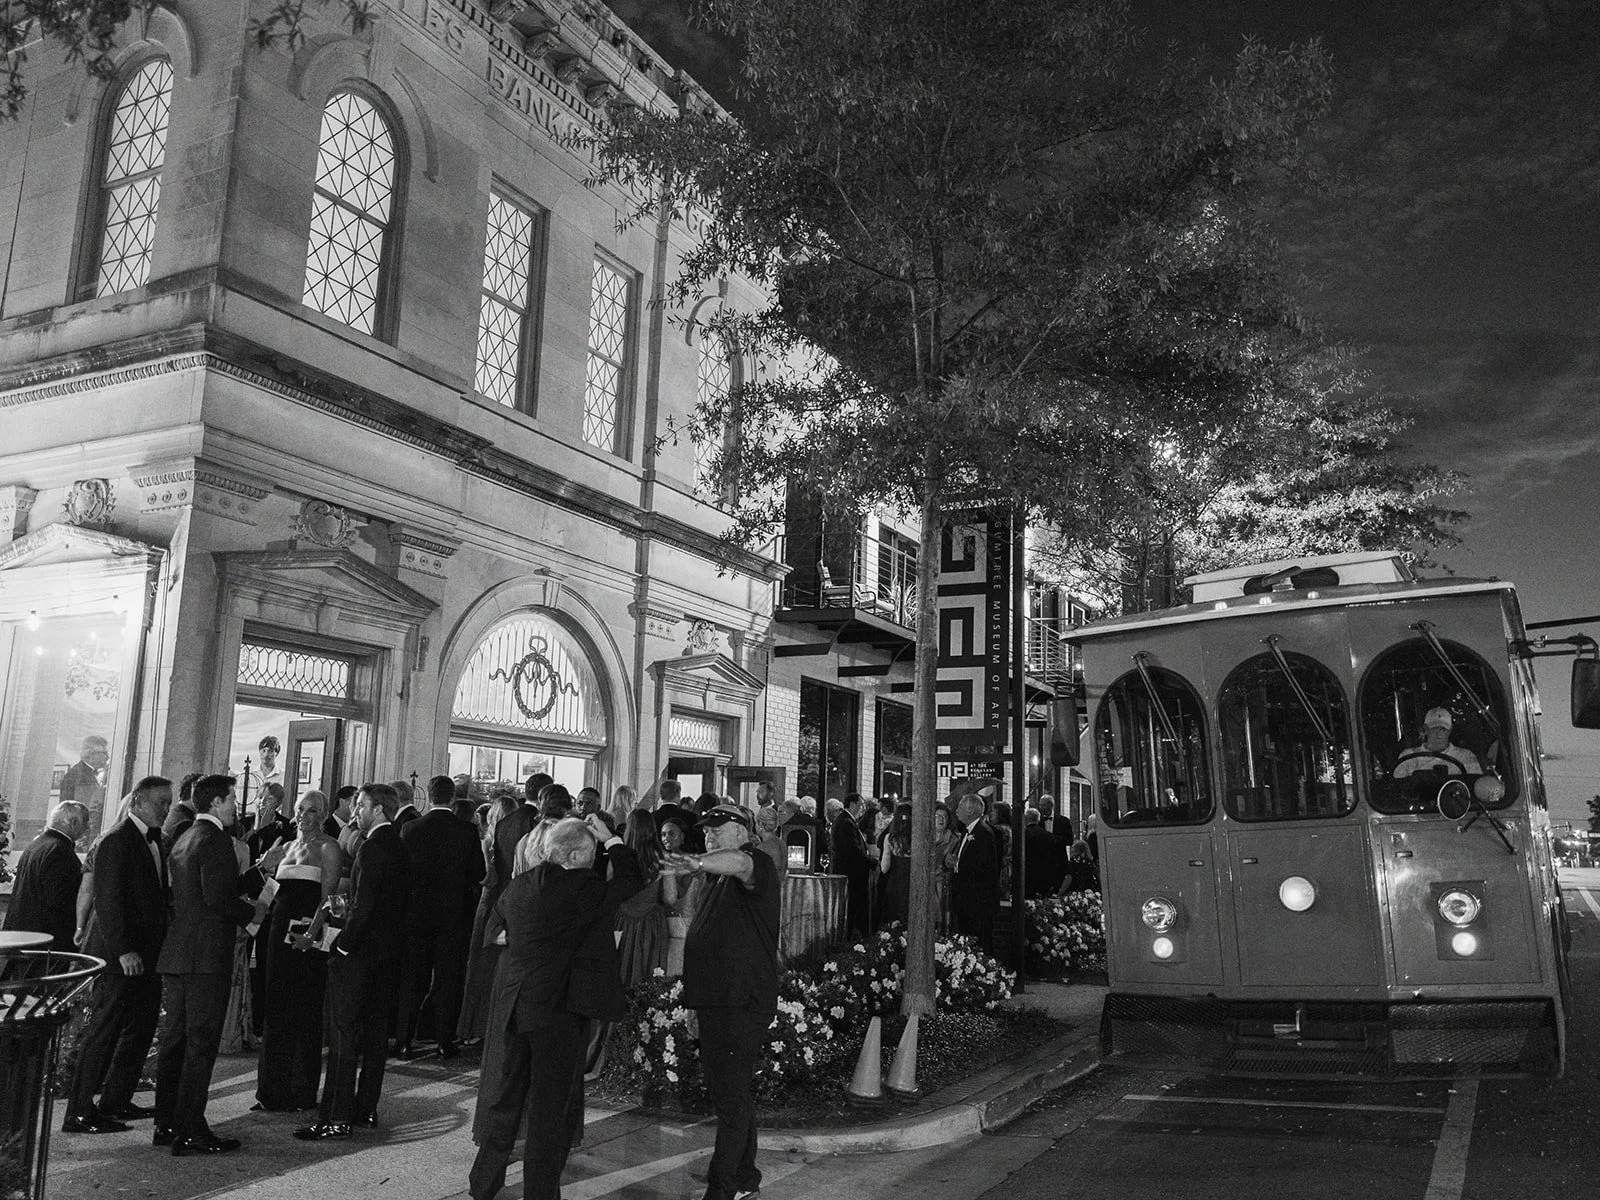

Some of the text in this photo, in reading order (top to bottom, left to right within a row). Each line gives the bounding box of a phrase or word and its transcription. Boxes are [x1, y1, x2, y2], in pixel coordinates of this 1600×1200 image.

[486, 56, 564, 145] BANK
[991, 520, 1002, 729] GUMTREE MUSEUM OF ART
